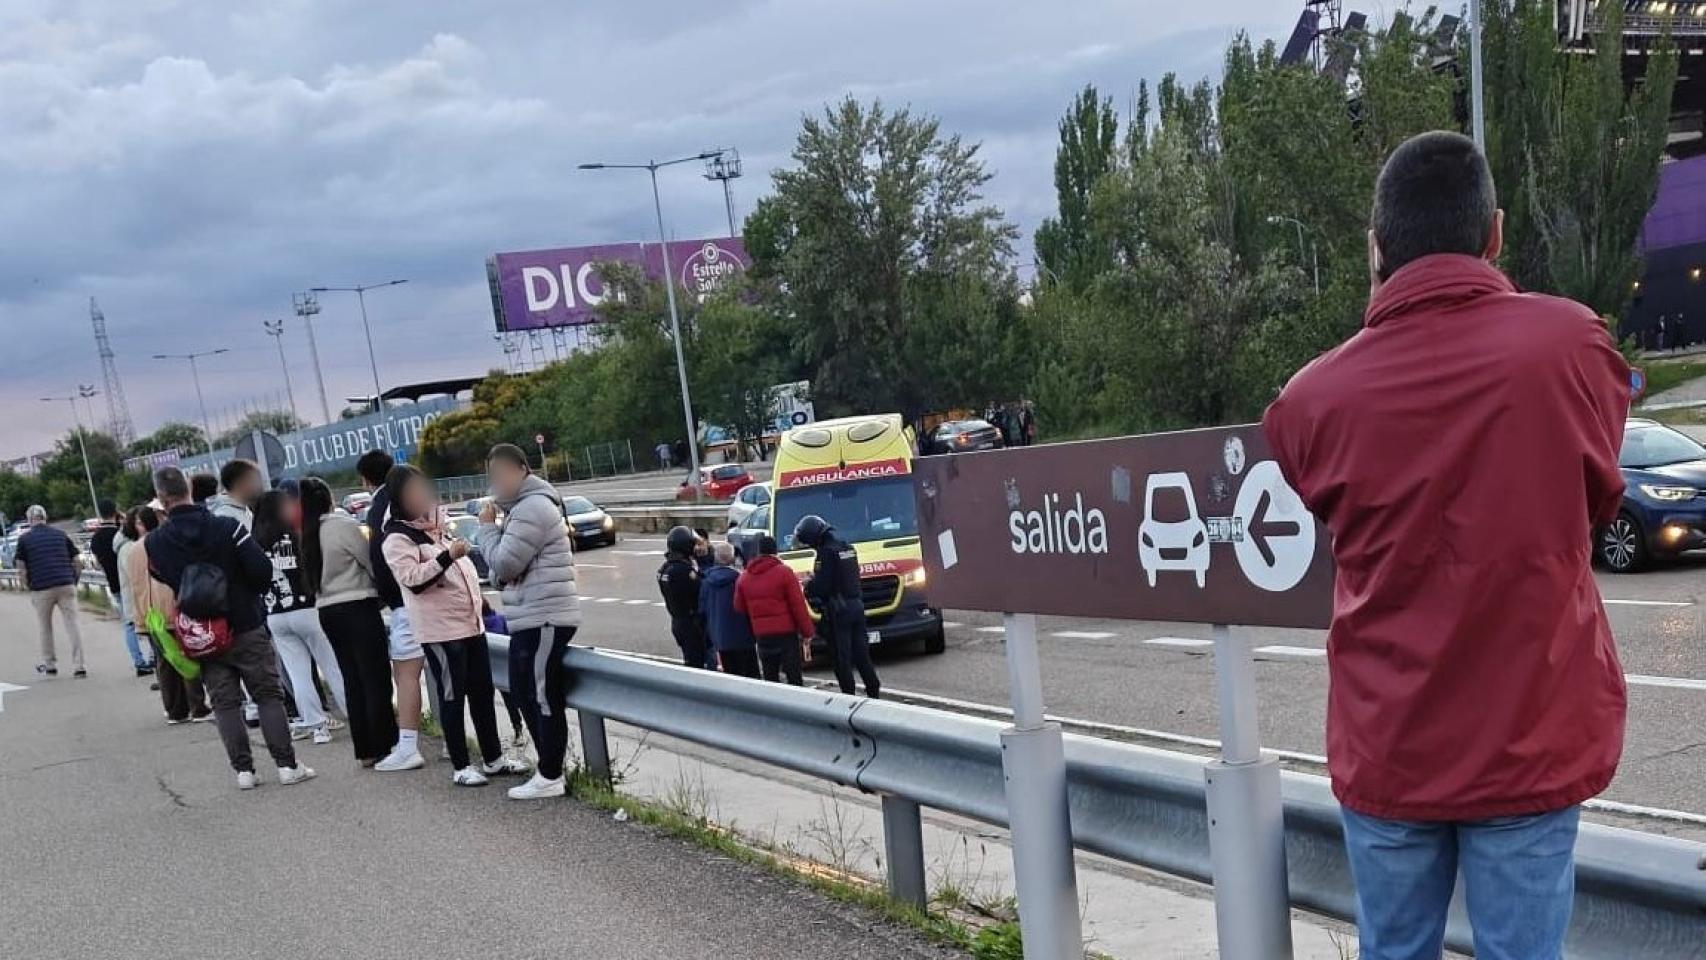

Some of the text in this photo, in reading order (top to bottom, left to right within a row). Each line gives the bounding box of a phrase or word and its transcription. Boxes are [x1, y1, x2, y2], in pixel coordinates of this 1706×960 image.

[302, 433, 346, 466] CLUB
[346, 427, 371, 456] DE
[790, 465, 897, 486] AMBULANCIA
[1009, 491, 1108, 554] salida
